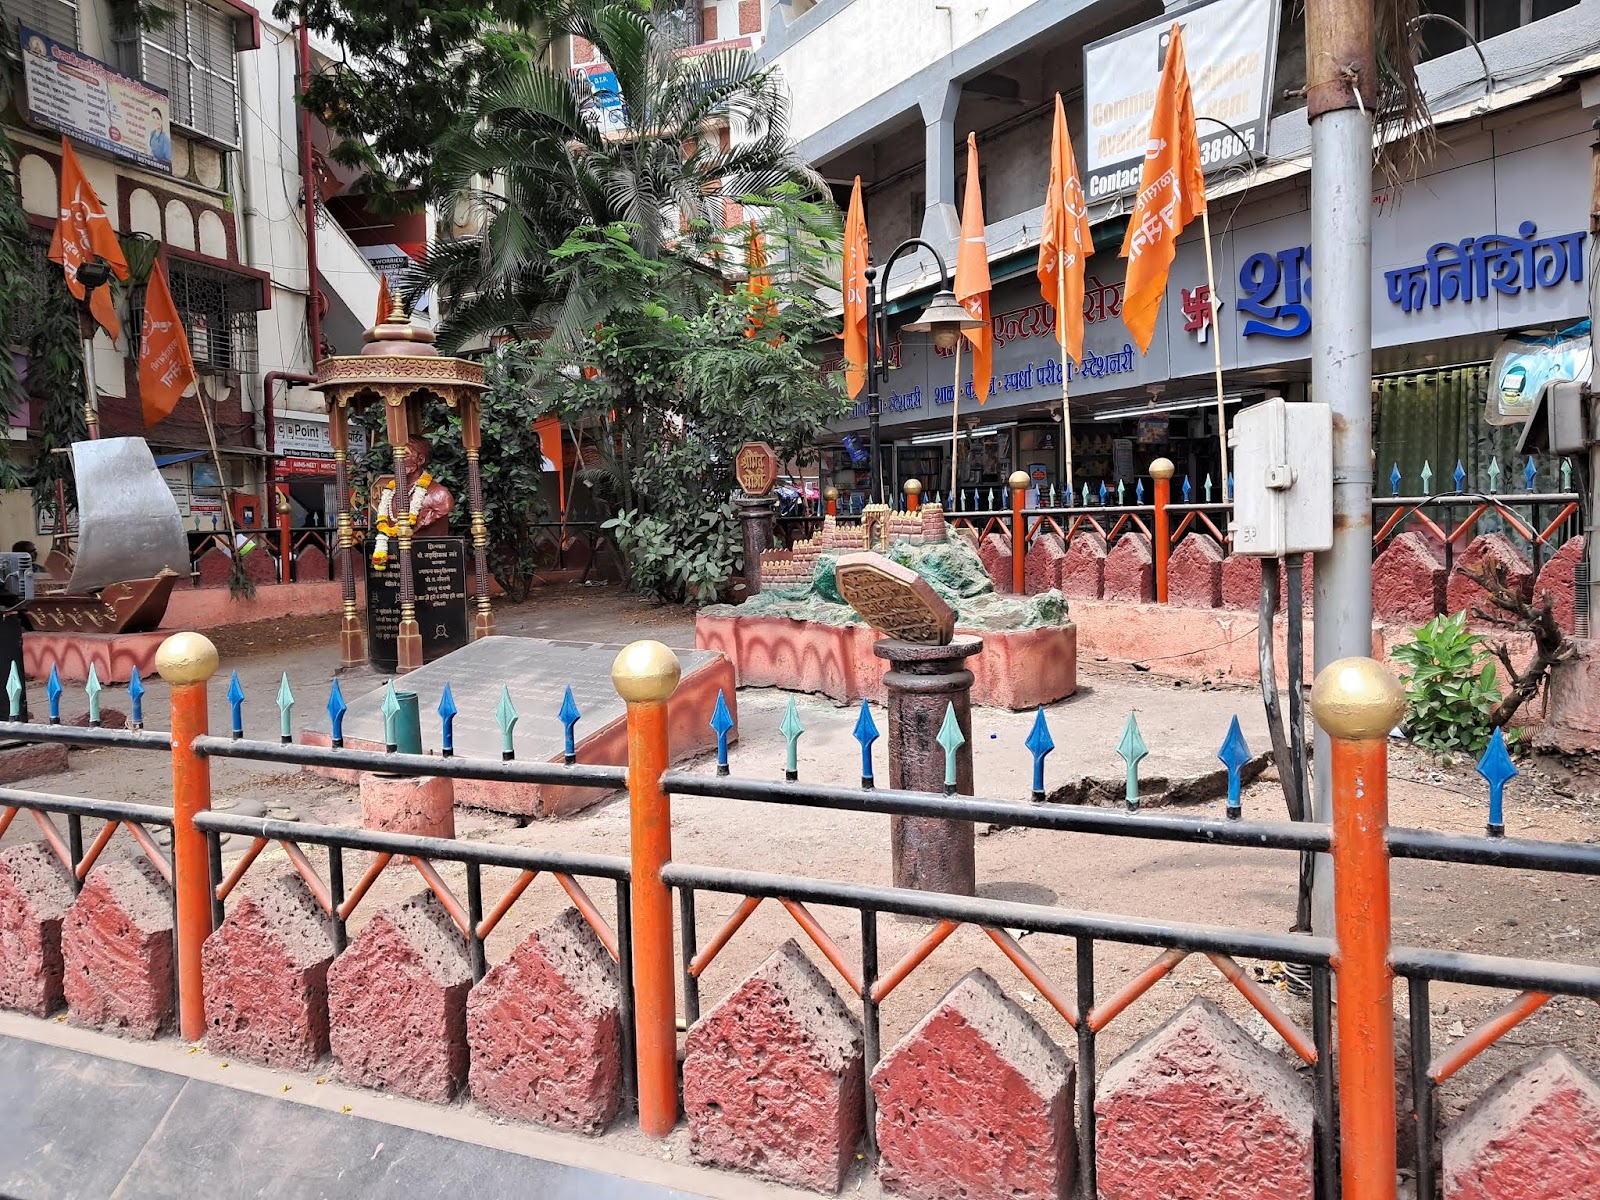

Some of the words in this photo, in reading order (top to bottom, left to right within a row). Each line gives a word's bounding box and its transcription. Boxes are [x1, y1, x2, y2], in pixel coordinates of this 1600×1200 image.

[1384, 219, 1588, 313] फर्निशिंग
[1004, 361, 1033, 392] स्पर्धा
[1081, 343, 1135, 378] स्टेशनरी
[889, 384, 923, 412] स्टेशनरी
[294, 424, 319, 438] Point
